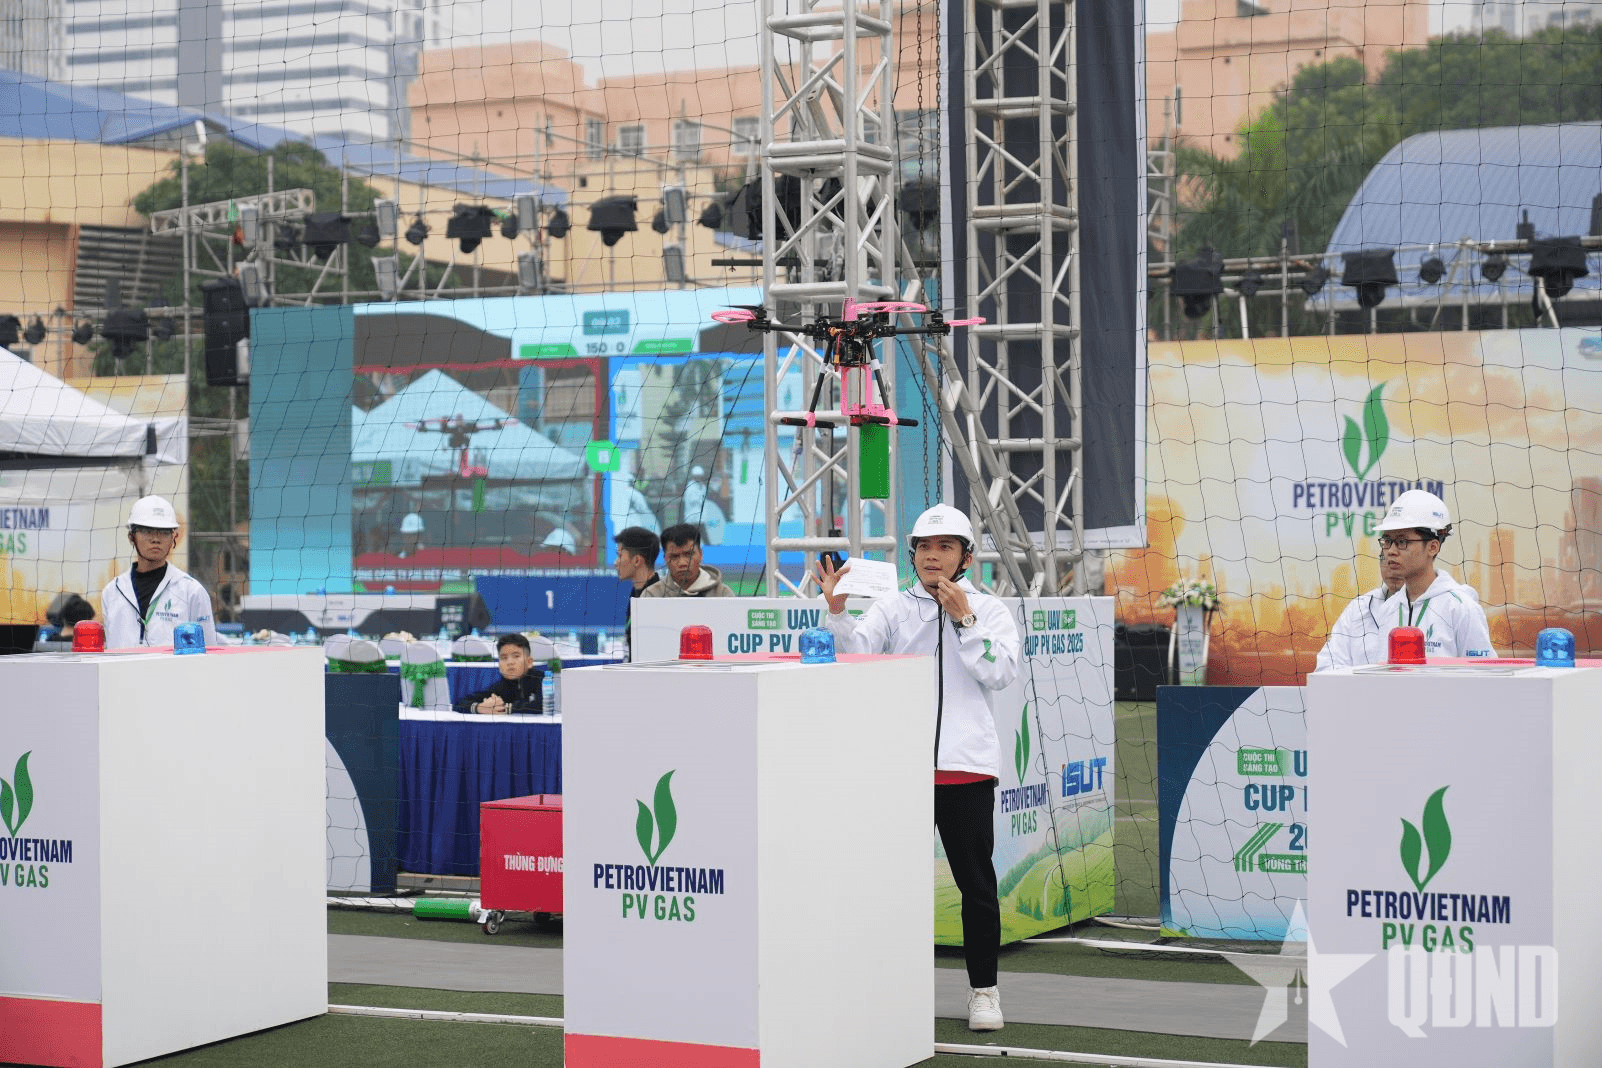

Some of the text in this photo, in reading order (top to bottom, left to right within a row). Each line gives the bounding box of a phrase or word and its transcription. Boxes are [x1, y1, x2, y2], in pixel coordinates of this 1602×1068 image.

[586, 341, 625, 353] 150 0
[1293, 481, 1444, 508] PETROVIETM
[1326, 512, 1355, 539] PV
[545, 590, 554, 609] 1
[787, 608, 821, 631] UAV
[1047, 610, 1061, 630] UAV
[727, 633, 792, 654] CUP PV
[1024, 632, 1083, 656] CUP PV GAS 2025
[1264, 753, 1275, 762] THI
[1264, 764, 1278, 774] TẠO
[1001, 783, 1047, 813] PETROVIETNAM
[1244, 783, 1294, 812] CUP
[1011, 810, 1037, 837] PV GAS
[504, 851, 535, 871] THÙNG
[15, 863, 49, 888] GAS
[594, 863, 724, 894] PETROVIETNAM
[622, 893, 695, 922] PV GAS
[1347, 889, 1511, 924] PETROVIETNAM
[1382, 922, 1474, 954] PV GAS
